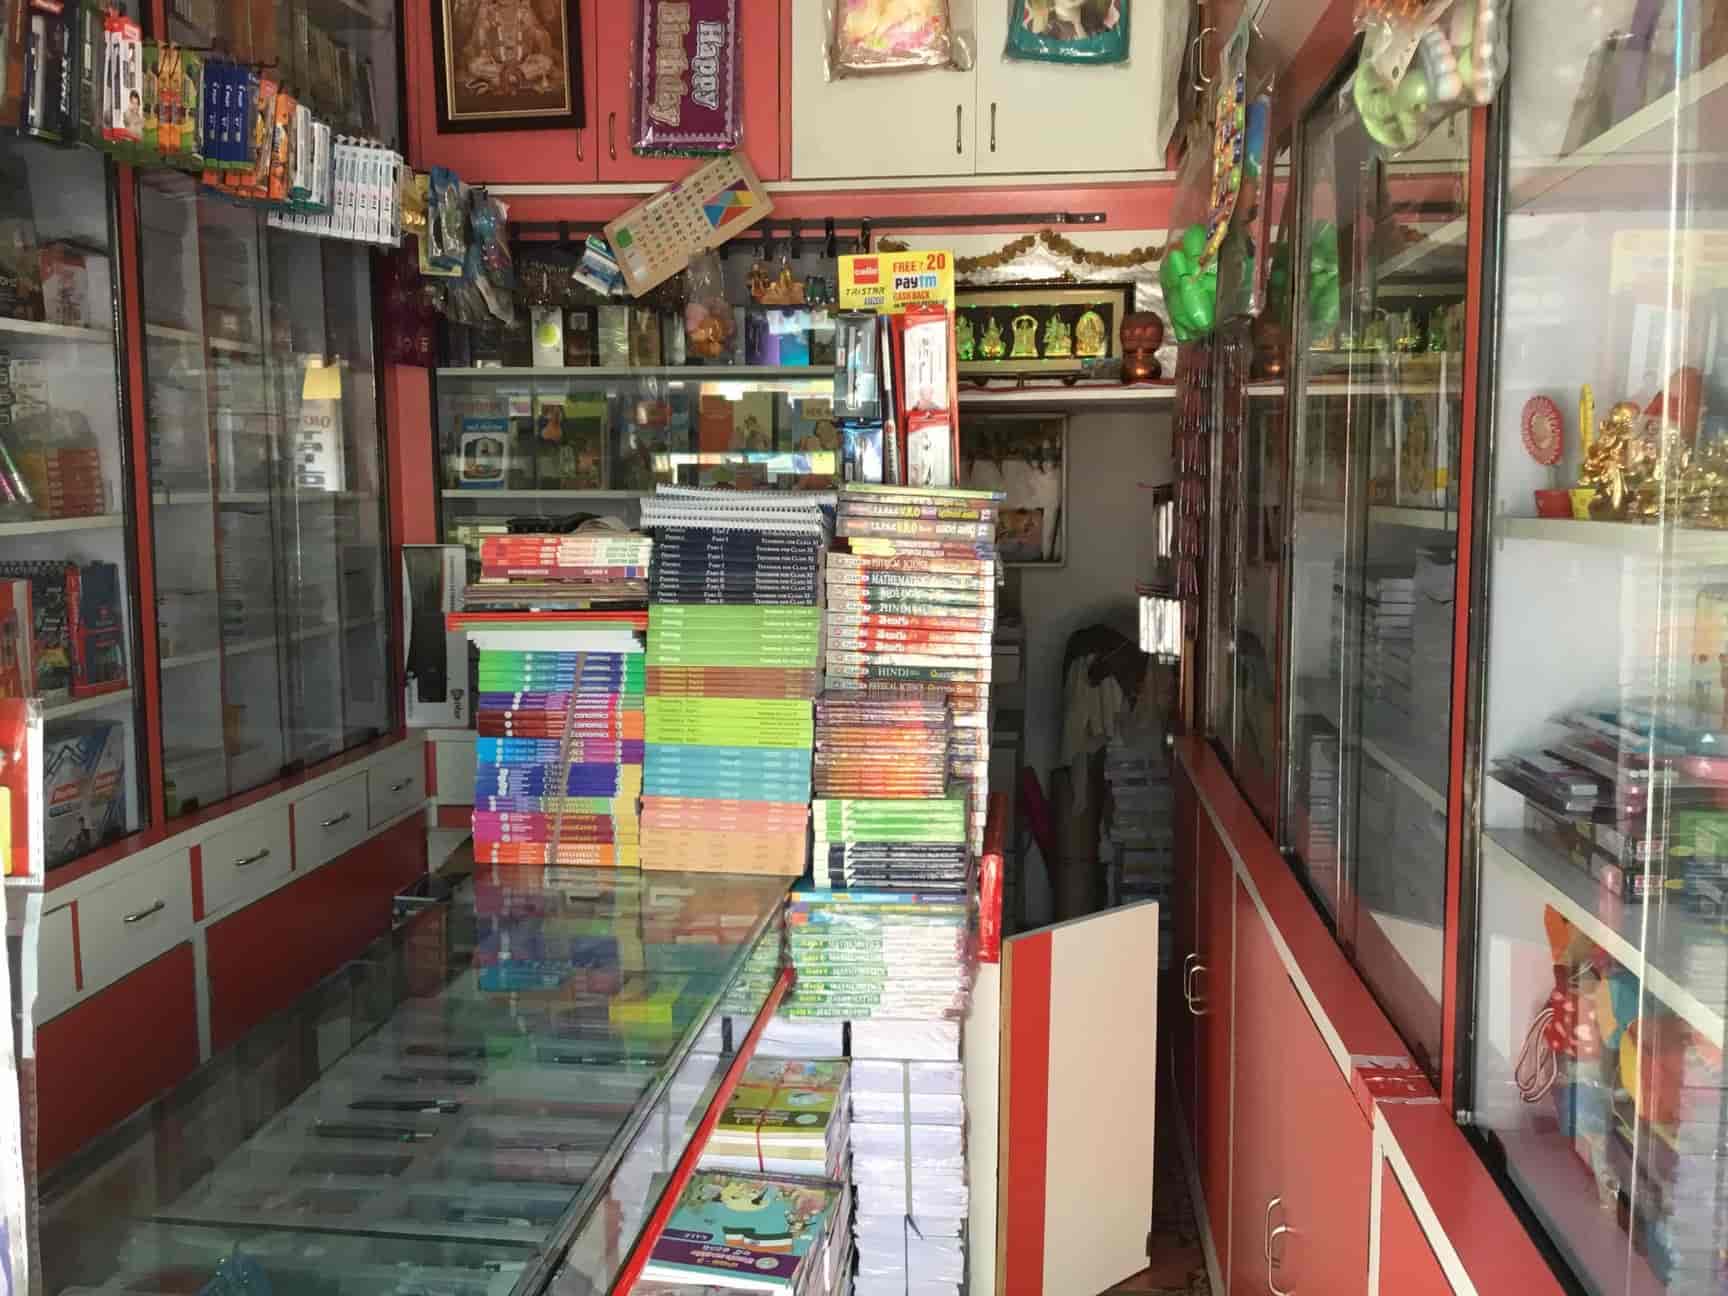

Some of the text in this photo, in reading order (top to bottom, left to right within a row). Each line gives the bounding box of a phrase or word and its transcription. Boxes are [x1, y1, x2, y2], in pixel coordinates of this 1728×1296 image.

[648, 1, 690, 127] Birthday
[691, 21, 727, 110] Happy
[893, 262, 917, 273] FREE
[926, 253, 946, 271] 20
[878, 667, 910, 677] HINDI
